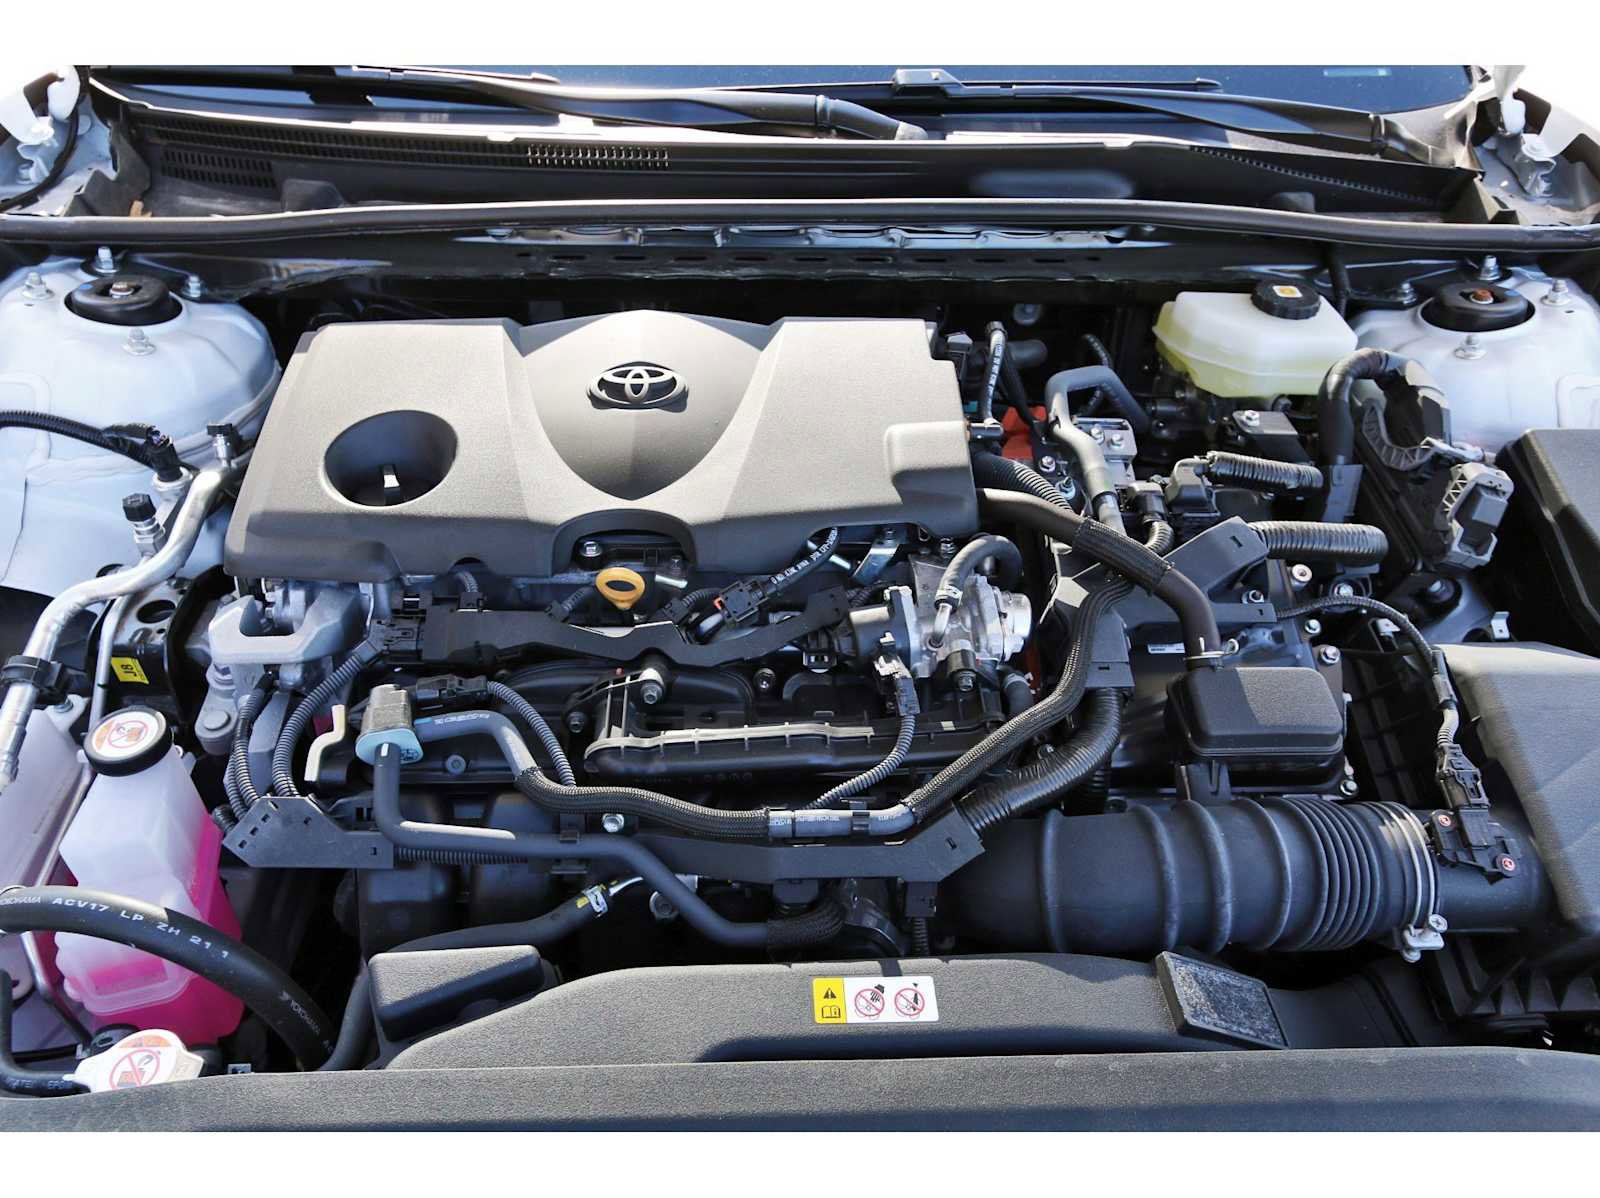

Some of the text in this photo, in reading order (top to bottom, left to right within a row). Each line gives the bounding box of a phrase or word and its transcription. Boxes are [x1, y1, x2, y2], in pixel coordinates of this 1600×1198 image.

[52, 897, 110, 912] ACV17
[120, 910, 145, 921] LP
[156, 921, 181, 936] ZH
